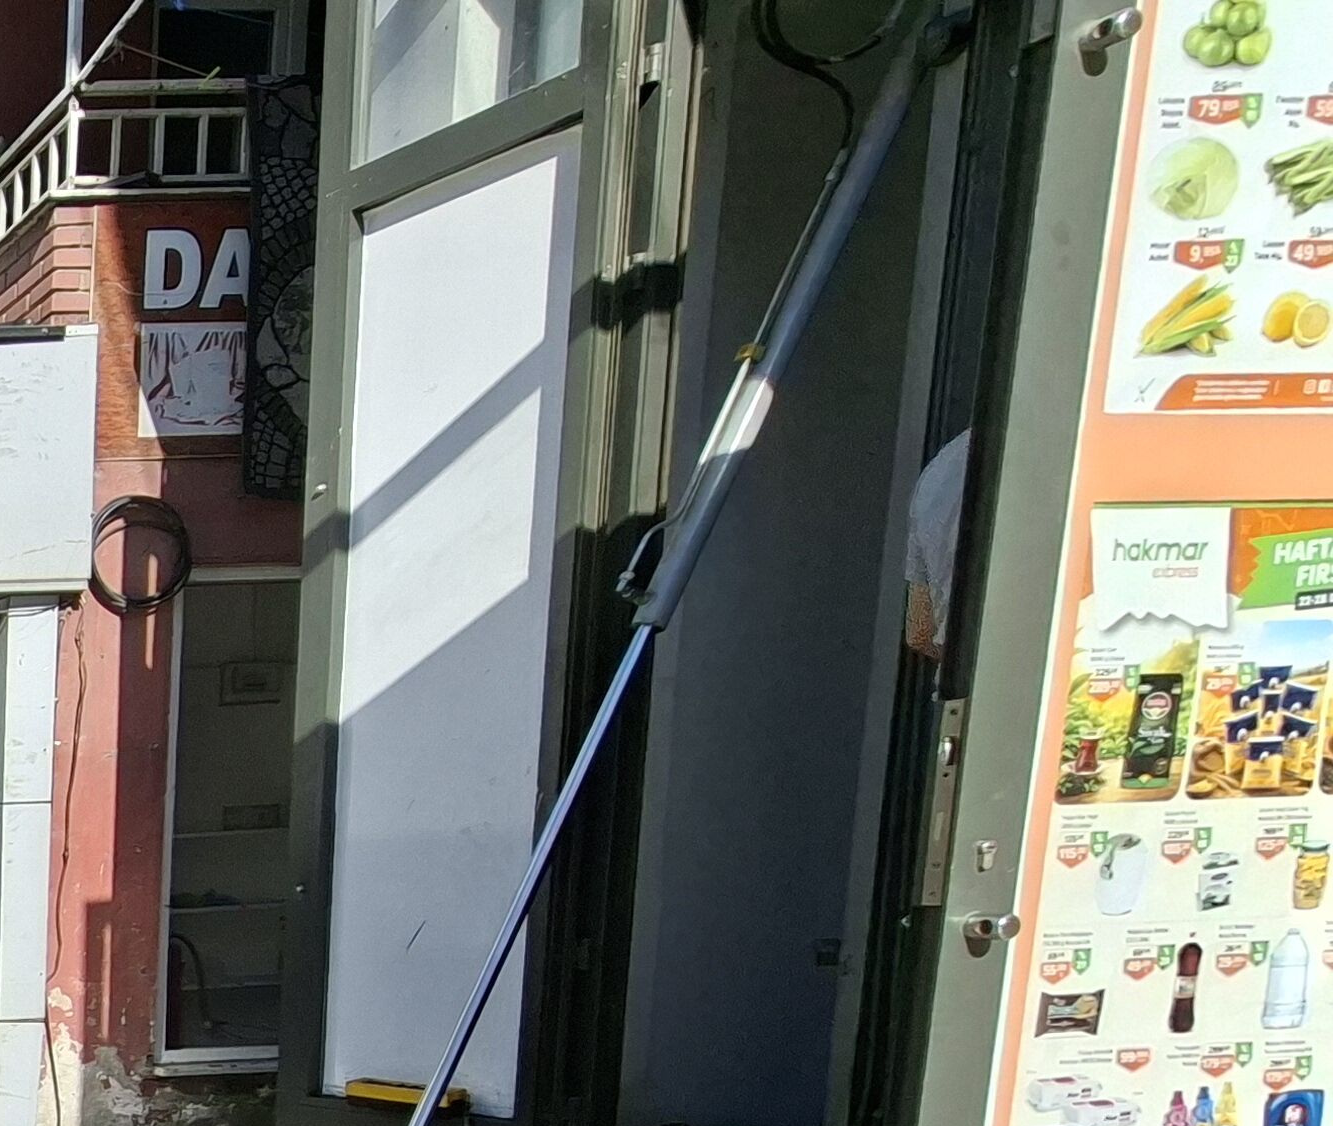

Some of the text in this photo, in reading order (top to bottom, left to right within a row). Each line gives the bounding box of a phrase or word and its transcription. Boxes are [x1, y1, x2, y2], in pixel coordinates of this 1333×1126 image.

[1112, 538, 1209, 561] hakmar
[1273, 537, 1333, 566] HAFT
[1295, 562, 1333, 588] FIR
